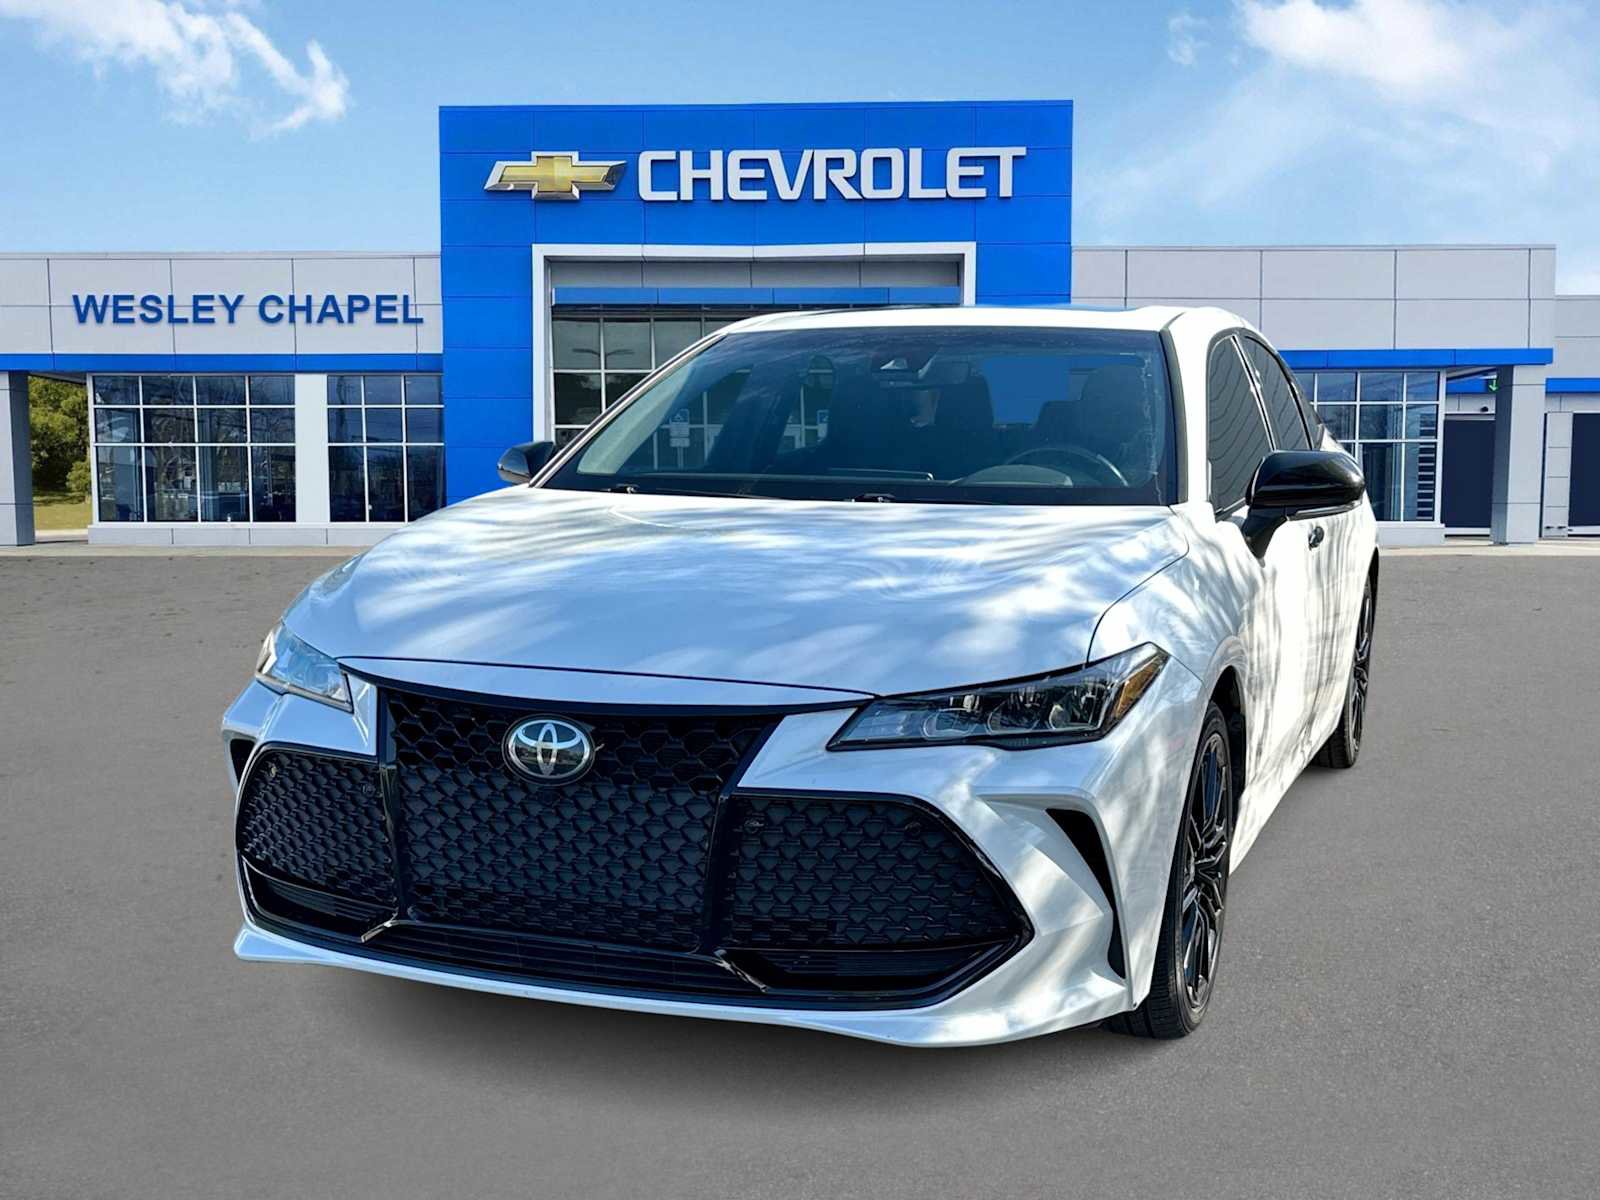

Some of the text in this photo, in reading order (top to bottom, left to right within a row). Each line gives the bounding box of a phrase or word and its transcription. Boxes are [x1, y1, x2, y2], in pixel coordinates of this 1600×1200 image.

[638, 146, 1027, 200] CHEVROLET
[72, 294, 424, 324] WESLEY CHAPEL
